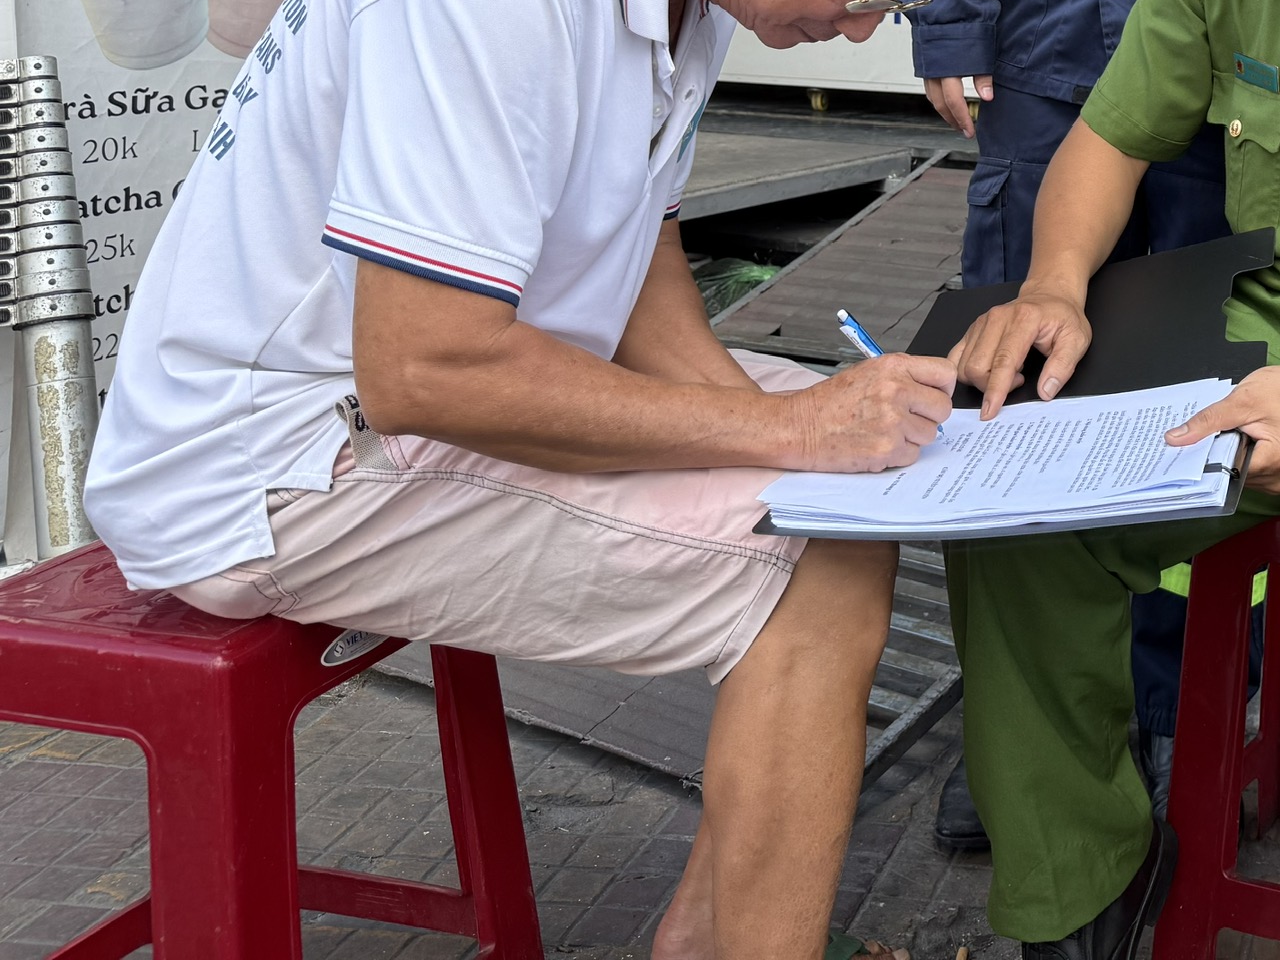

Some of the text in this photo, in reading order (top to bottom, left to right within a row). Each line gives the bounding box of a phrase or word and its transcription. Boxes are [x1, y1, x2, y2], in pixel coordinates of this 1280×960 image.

[64, 93, 97, 120] rà
[107, 87, 176, 118] Sữa
[185, 84, 228, 114] Gạ
[83, 136, 138, 164] 20k
[78, 186, 163, 218] atcha
[85, 233, 136, 264] 25k
